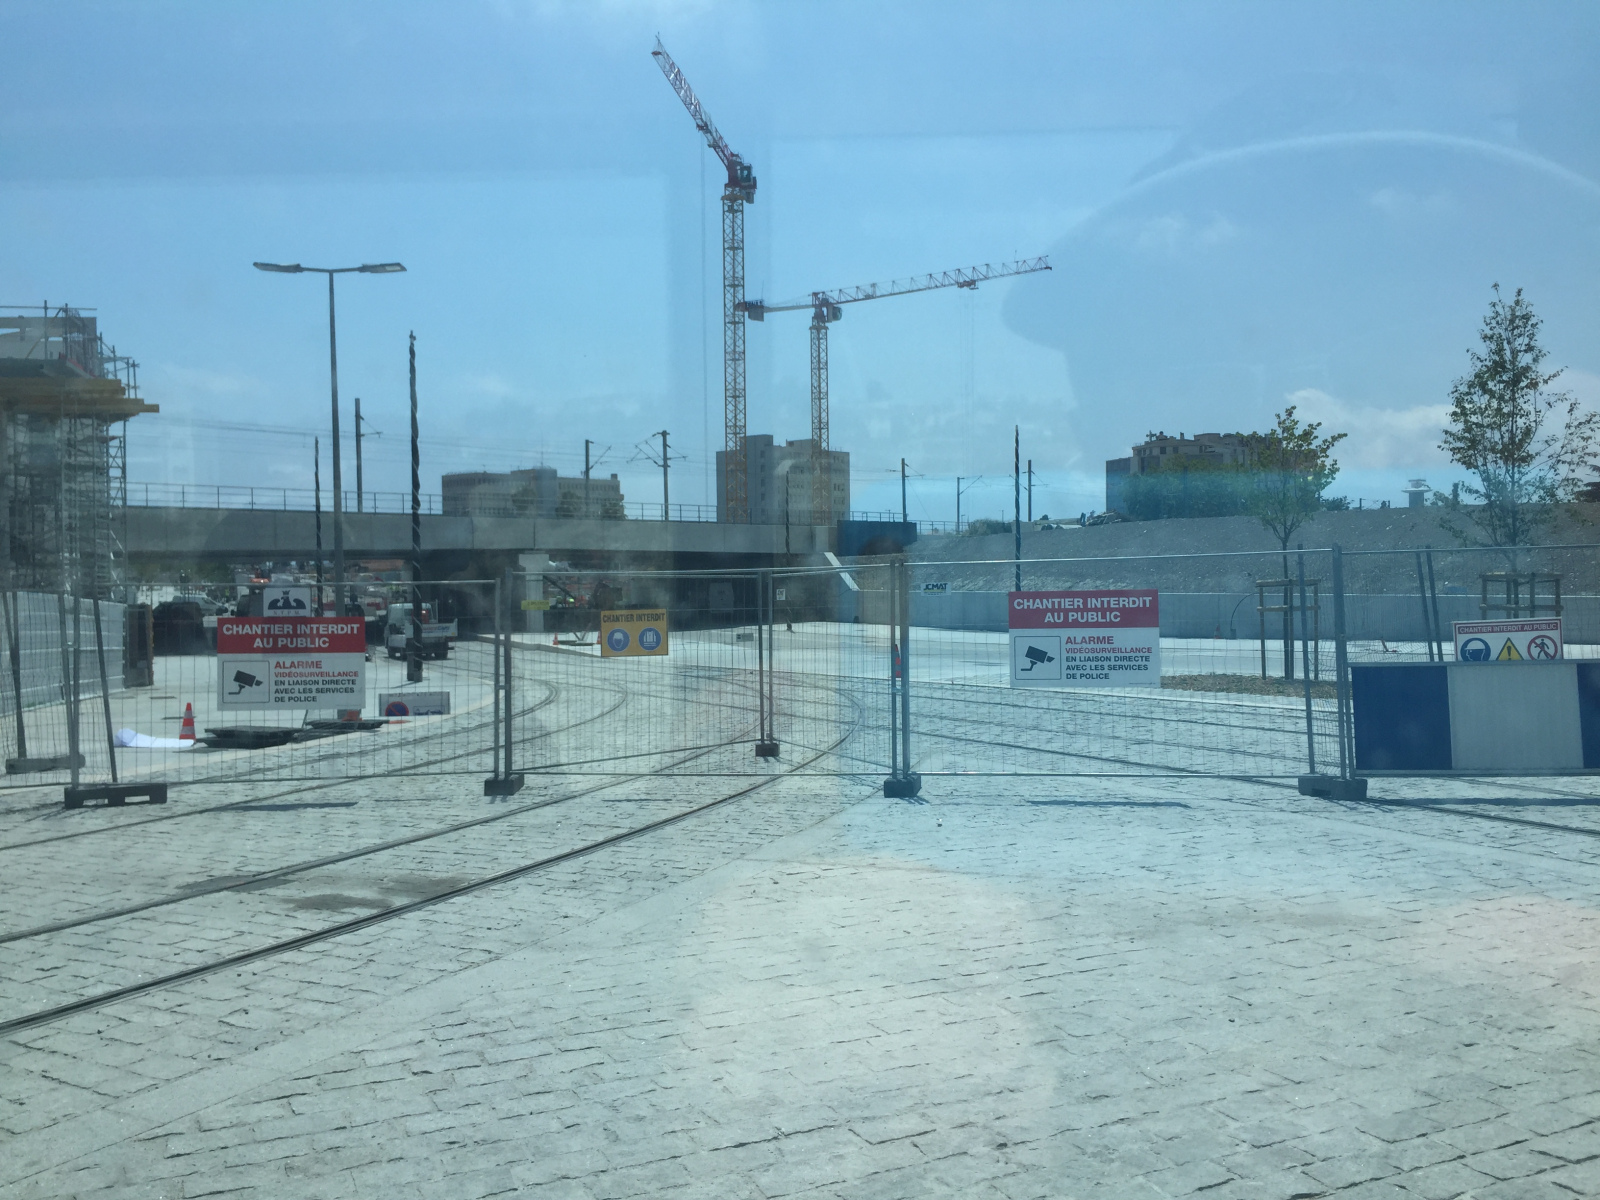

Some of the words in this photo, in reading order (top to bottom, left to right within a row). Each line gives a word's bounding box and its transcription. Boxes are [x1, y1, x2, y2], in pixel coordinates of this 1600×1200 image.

[1013, 598, 1083, 609] CHANTIER
[1087, 597, 1152, 608] INTERDIT
[602, 614, 634, 623] CHANTIER
[635, 612, 665, 622] INTERDIT
[1044, 612, 1064, 623] AU
[1068, 611, 1120, 622] PUBLIC
[222, 624, 292, 635] CHANTIER
[297, 624, 360, 634] INTERDIT
[253, 638, 273, 648] AU
[278, 637, 329, 648] PUBLIC
[1065, 636, 1114, 645] ALARME
[1065, 646, 1152, 654] VIDÉOSURVEILLANCE
[274, 660, 322, 669] ALARME
[274, 670, 359, 678] VIDÉOSURVEILLANCE
